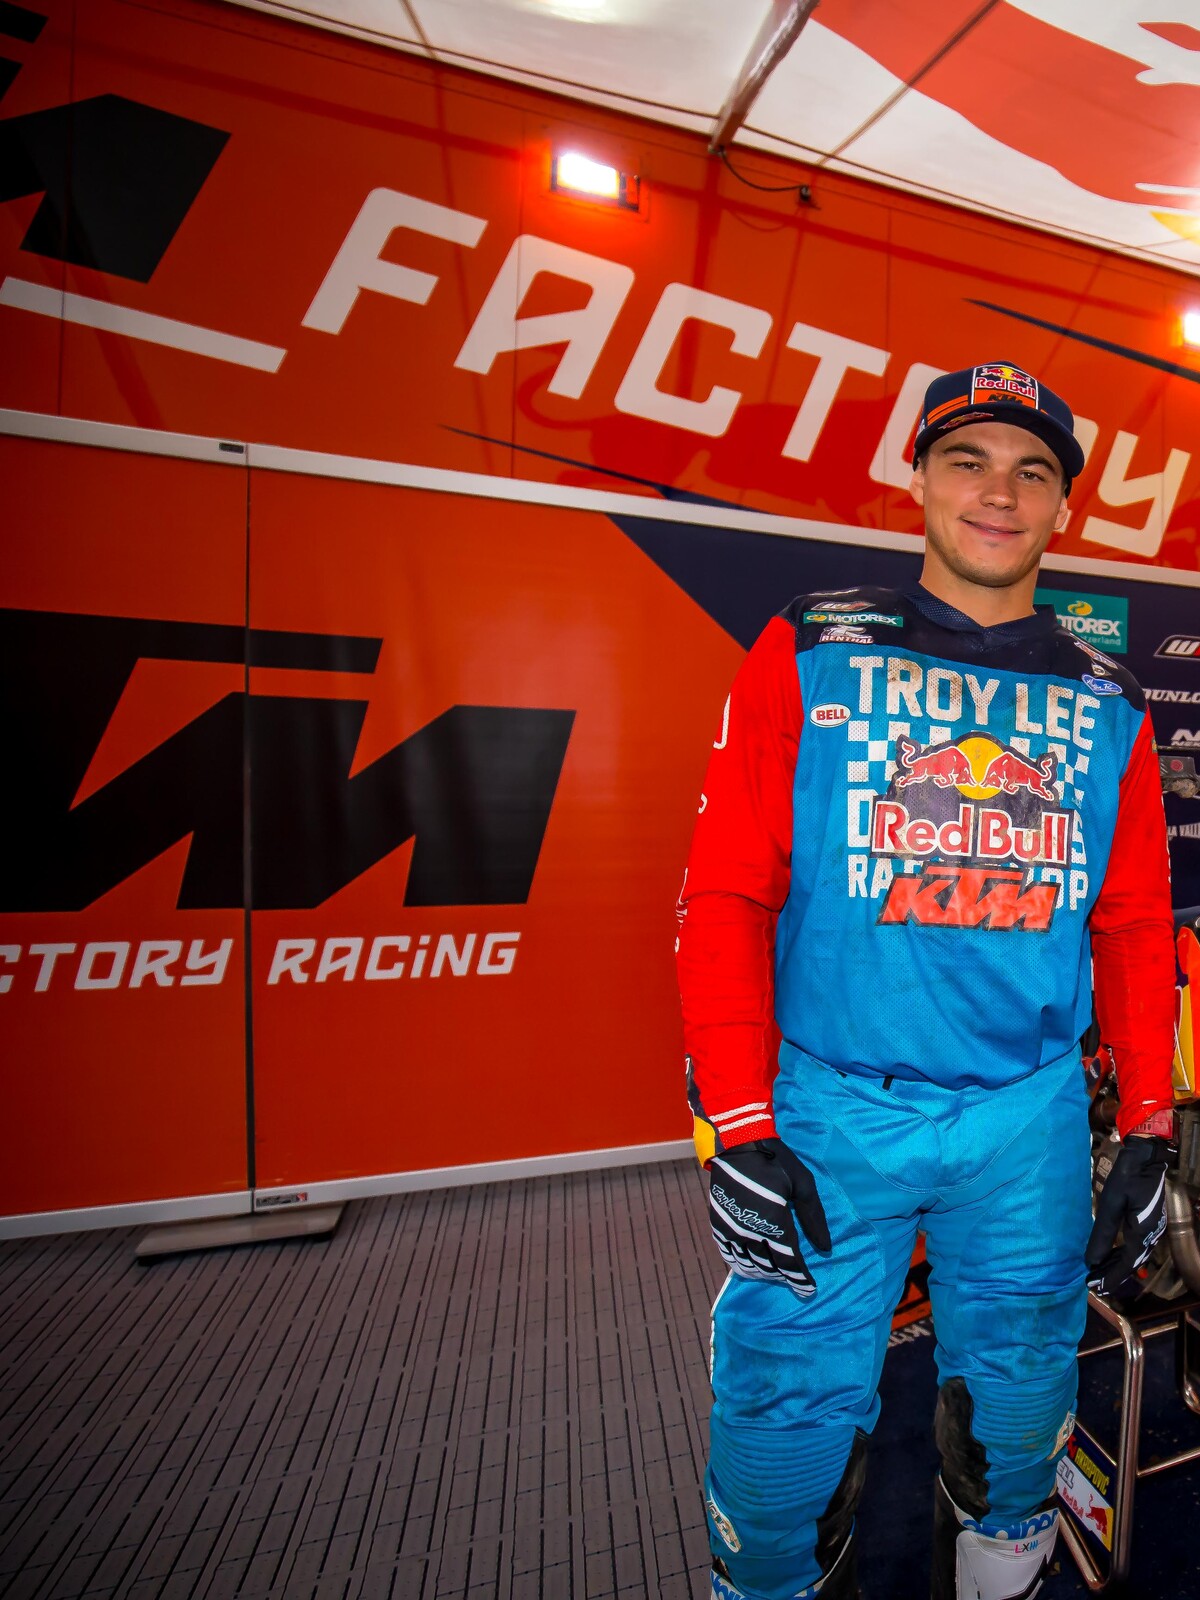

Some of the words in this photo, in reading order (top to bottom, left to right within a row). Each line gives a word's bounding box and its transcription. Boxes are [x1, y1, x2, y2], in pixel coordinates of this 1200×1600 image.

[301, 187, 1191, 557] FACTY
[975, 377, 1006, 389] Red
[1008, 381, 1036, 399] Bull
[828, 614, 898, 625] MOTOREX
[1056, 615, 1120, 636] TOREX
[821, 635, 875, 644] RENTHAL
[1080, 635, 1121, 646] tzerland
[849, 656, 1001, 726] TROY
[1015, 682, 1101, 751] LEE
[815, 708, 848, 722] BELL
[872, 801, 975, 854] Red
[977, 807, 1071, 865] Bull
[879, 864, 1057, 930] KTM
